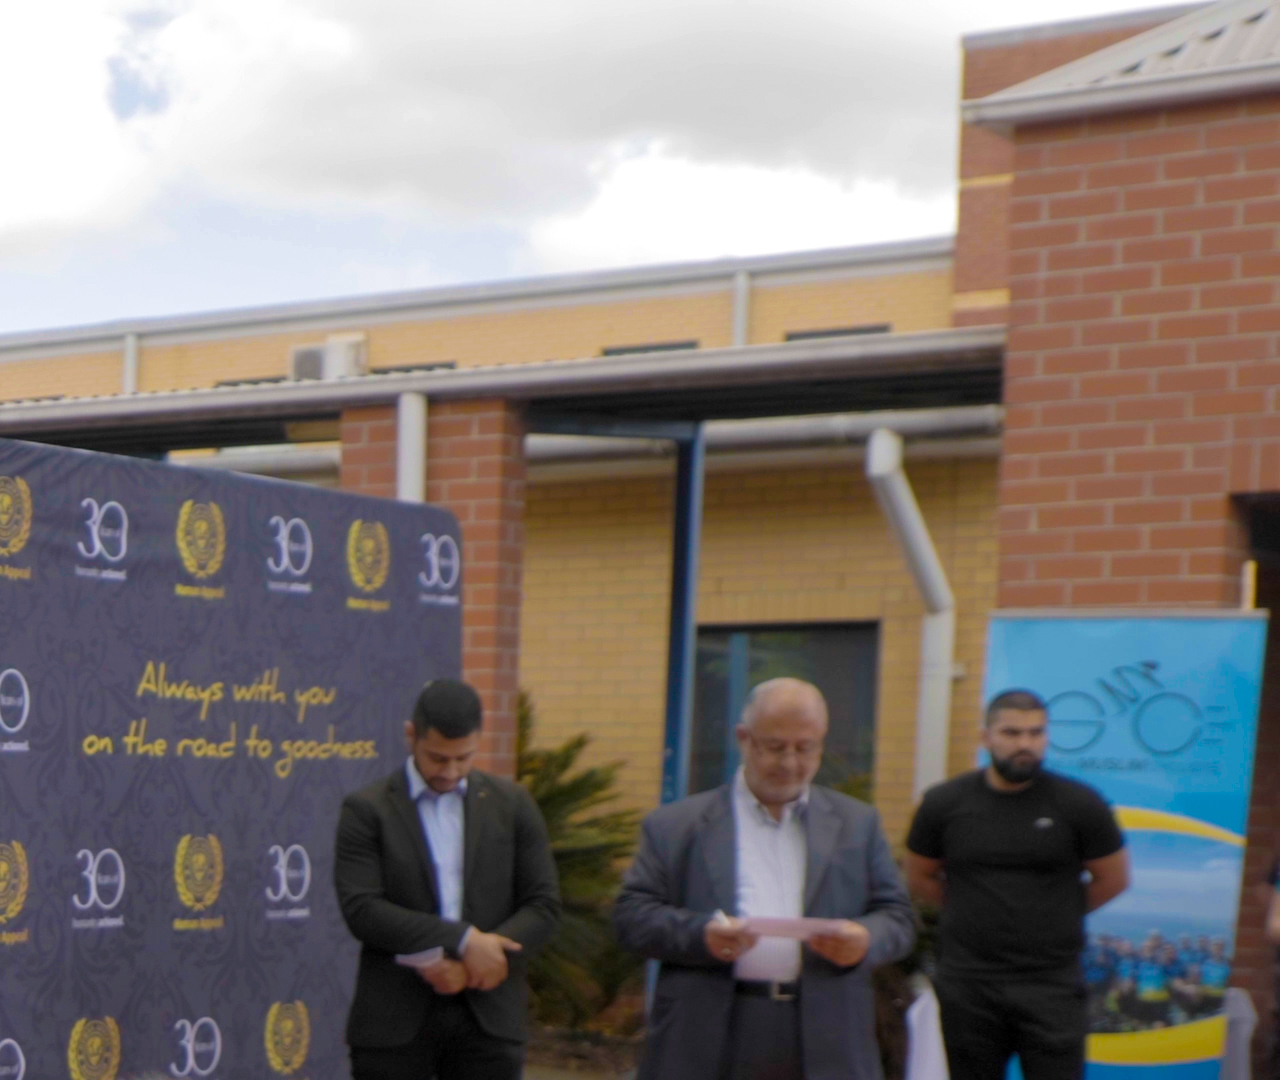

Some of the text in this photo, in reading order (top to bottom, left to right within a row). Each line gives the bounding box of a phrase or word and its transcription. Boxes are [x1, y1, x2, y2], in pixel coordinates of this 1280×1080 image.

[77, 497, 129, 562] 30
[267, 515, 313, 577] 30
[418, 532, 461, 590] 30
[136, 660, 337, 723] Always with you
[82, 734, 113, 756] on
[122, 717, 167, 757] the
[177, 721, 236, 758] road
[245, 724, 272, 758] to
[73, 848, 125, 910] 30
[265, 844, 311, 902] 30
[170, 1016, 222, 1077] 30
